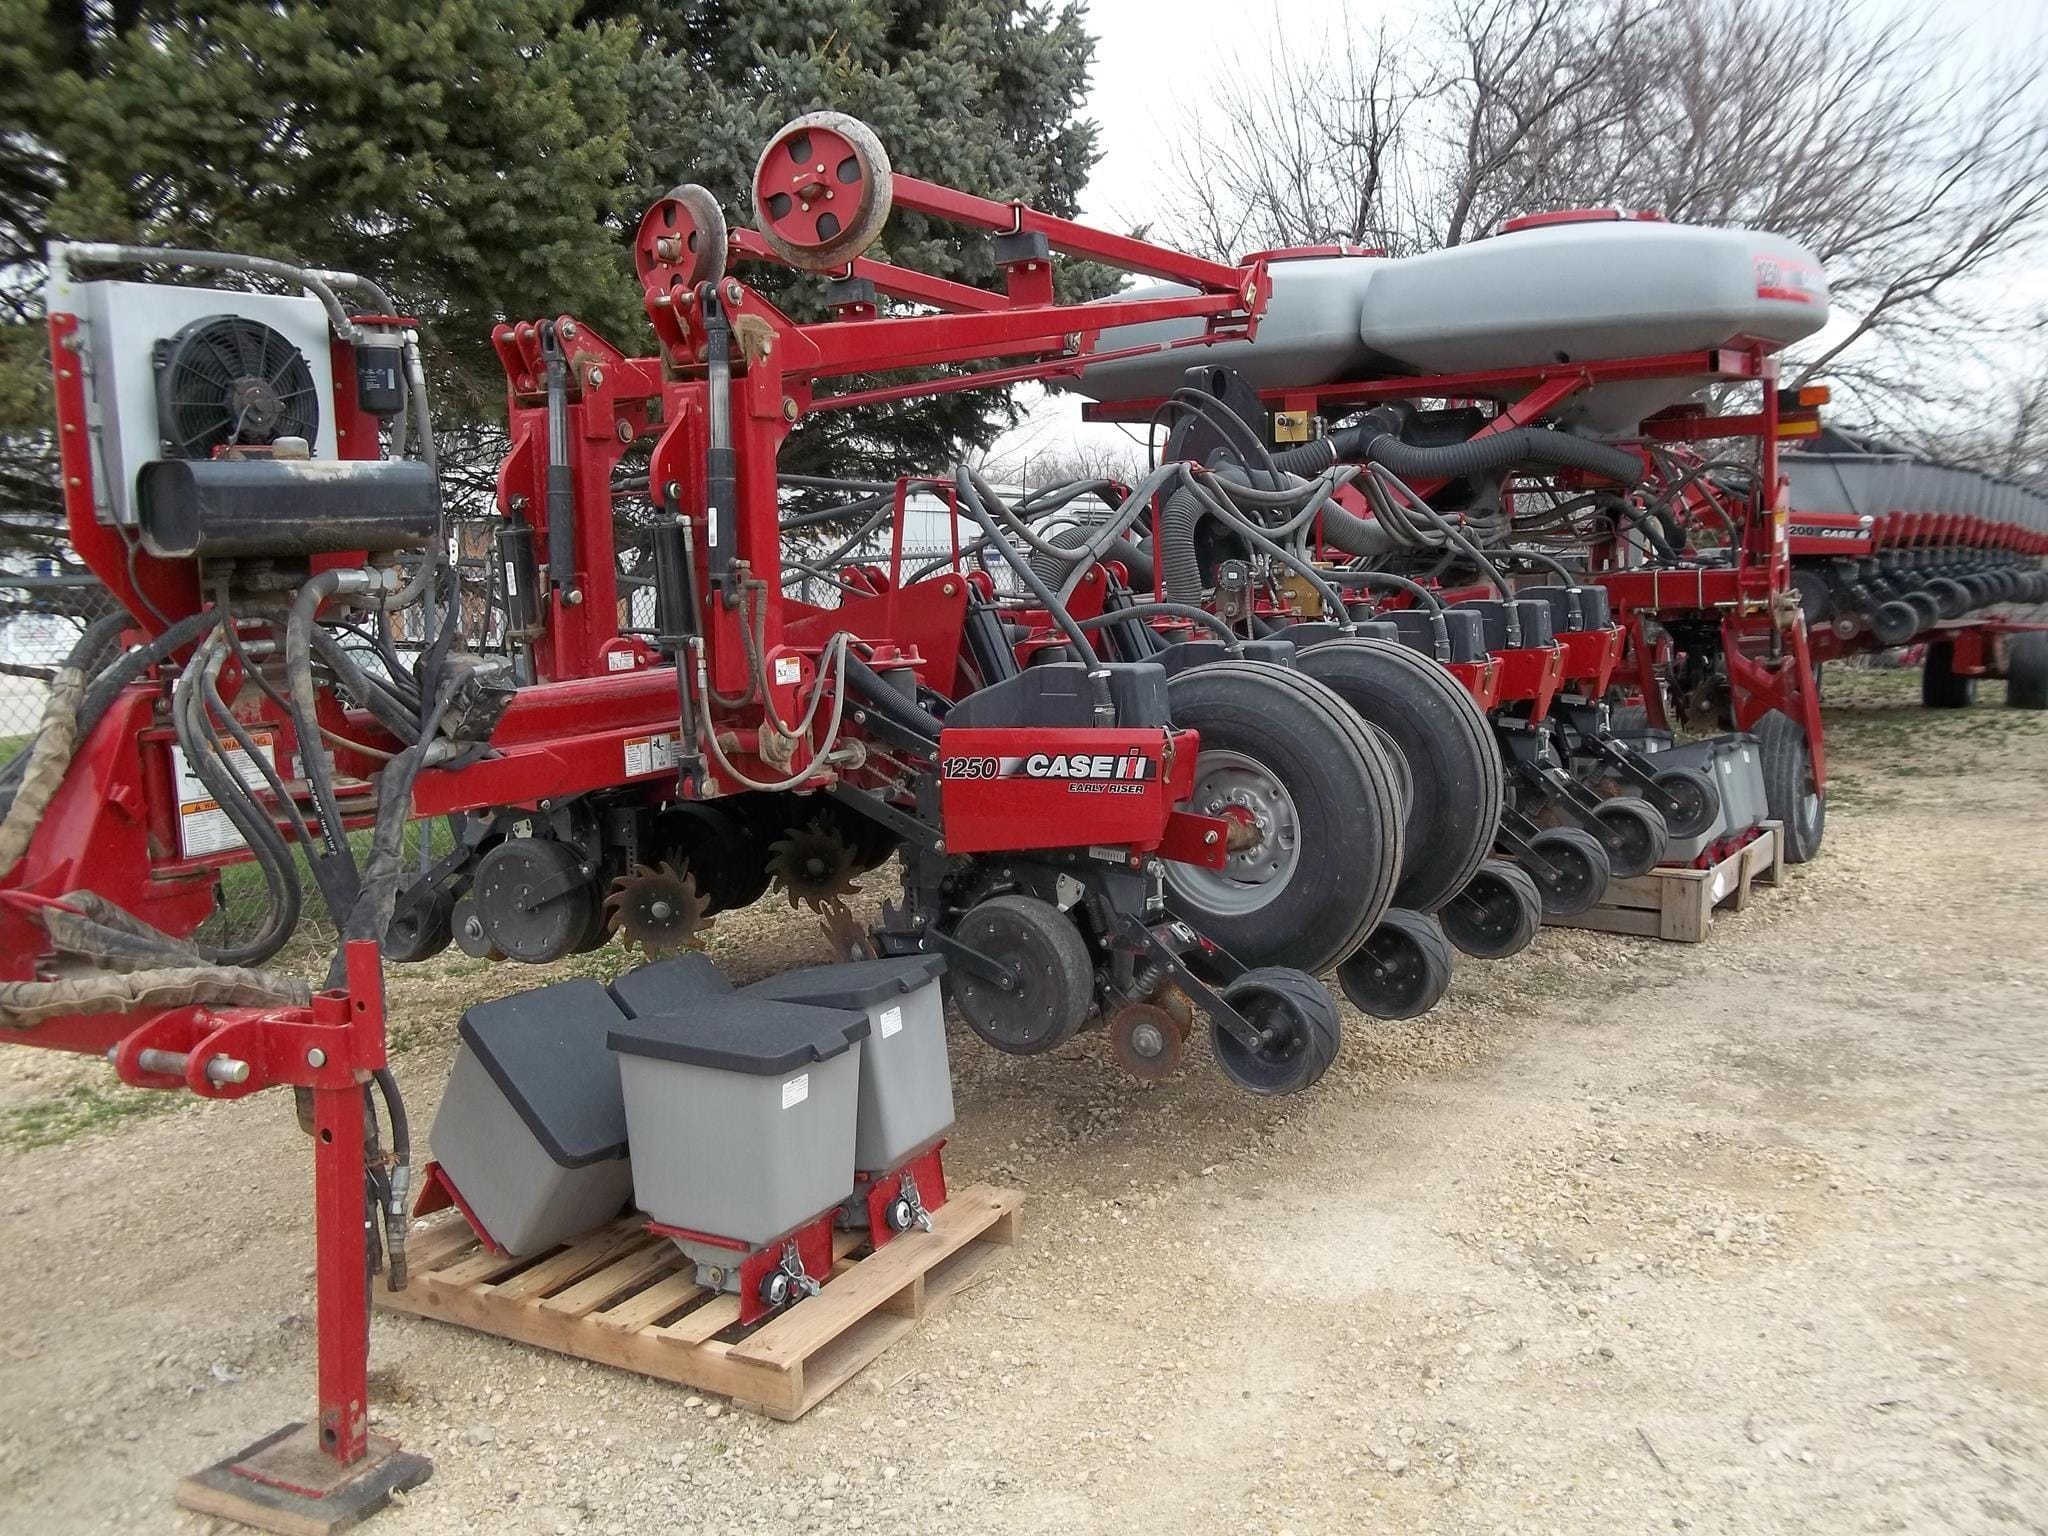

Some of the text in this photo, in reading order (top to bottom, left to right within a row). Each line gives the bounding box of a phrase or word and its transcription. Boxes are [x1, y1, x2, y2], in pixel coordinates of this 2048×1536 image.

[1788, 526, 1814, 536] 200
[1821, 529, 1857, 539] CASE
[222, 736, 267, 750] WANG
[943, 756, 998, 780] 1250
[1026, 754, 1114, 779] CASE
[1068, 783, 1144, 794] EARLY RISER
